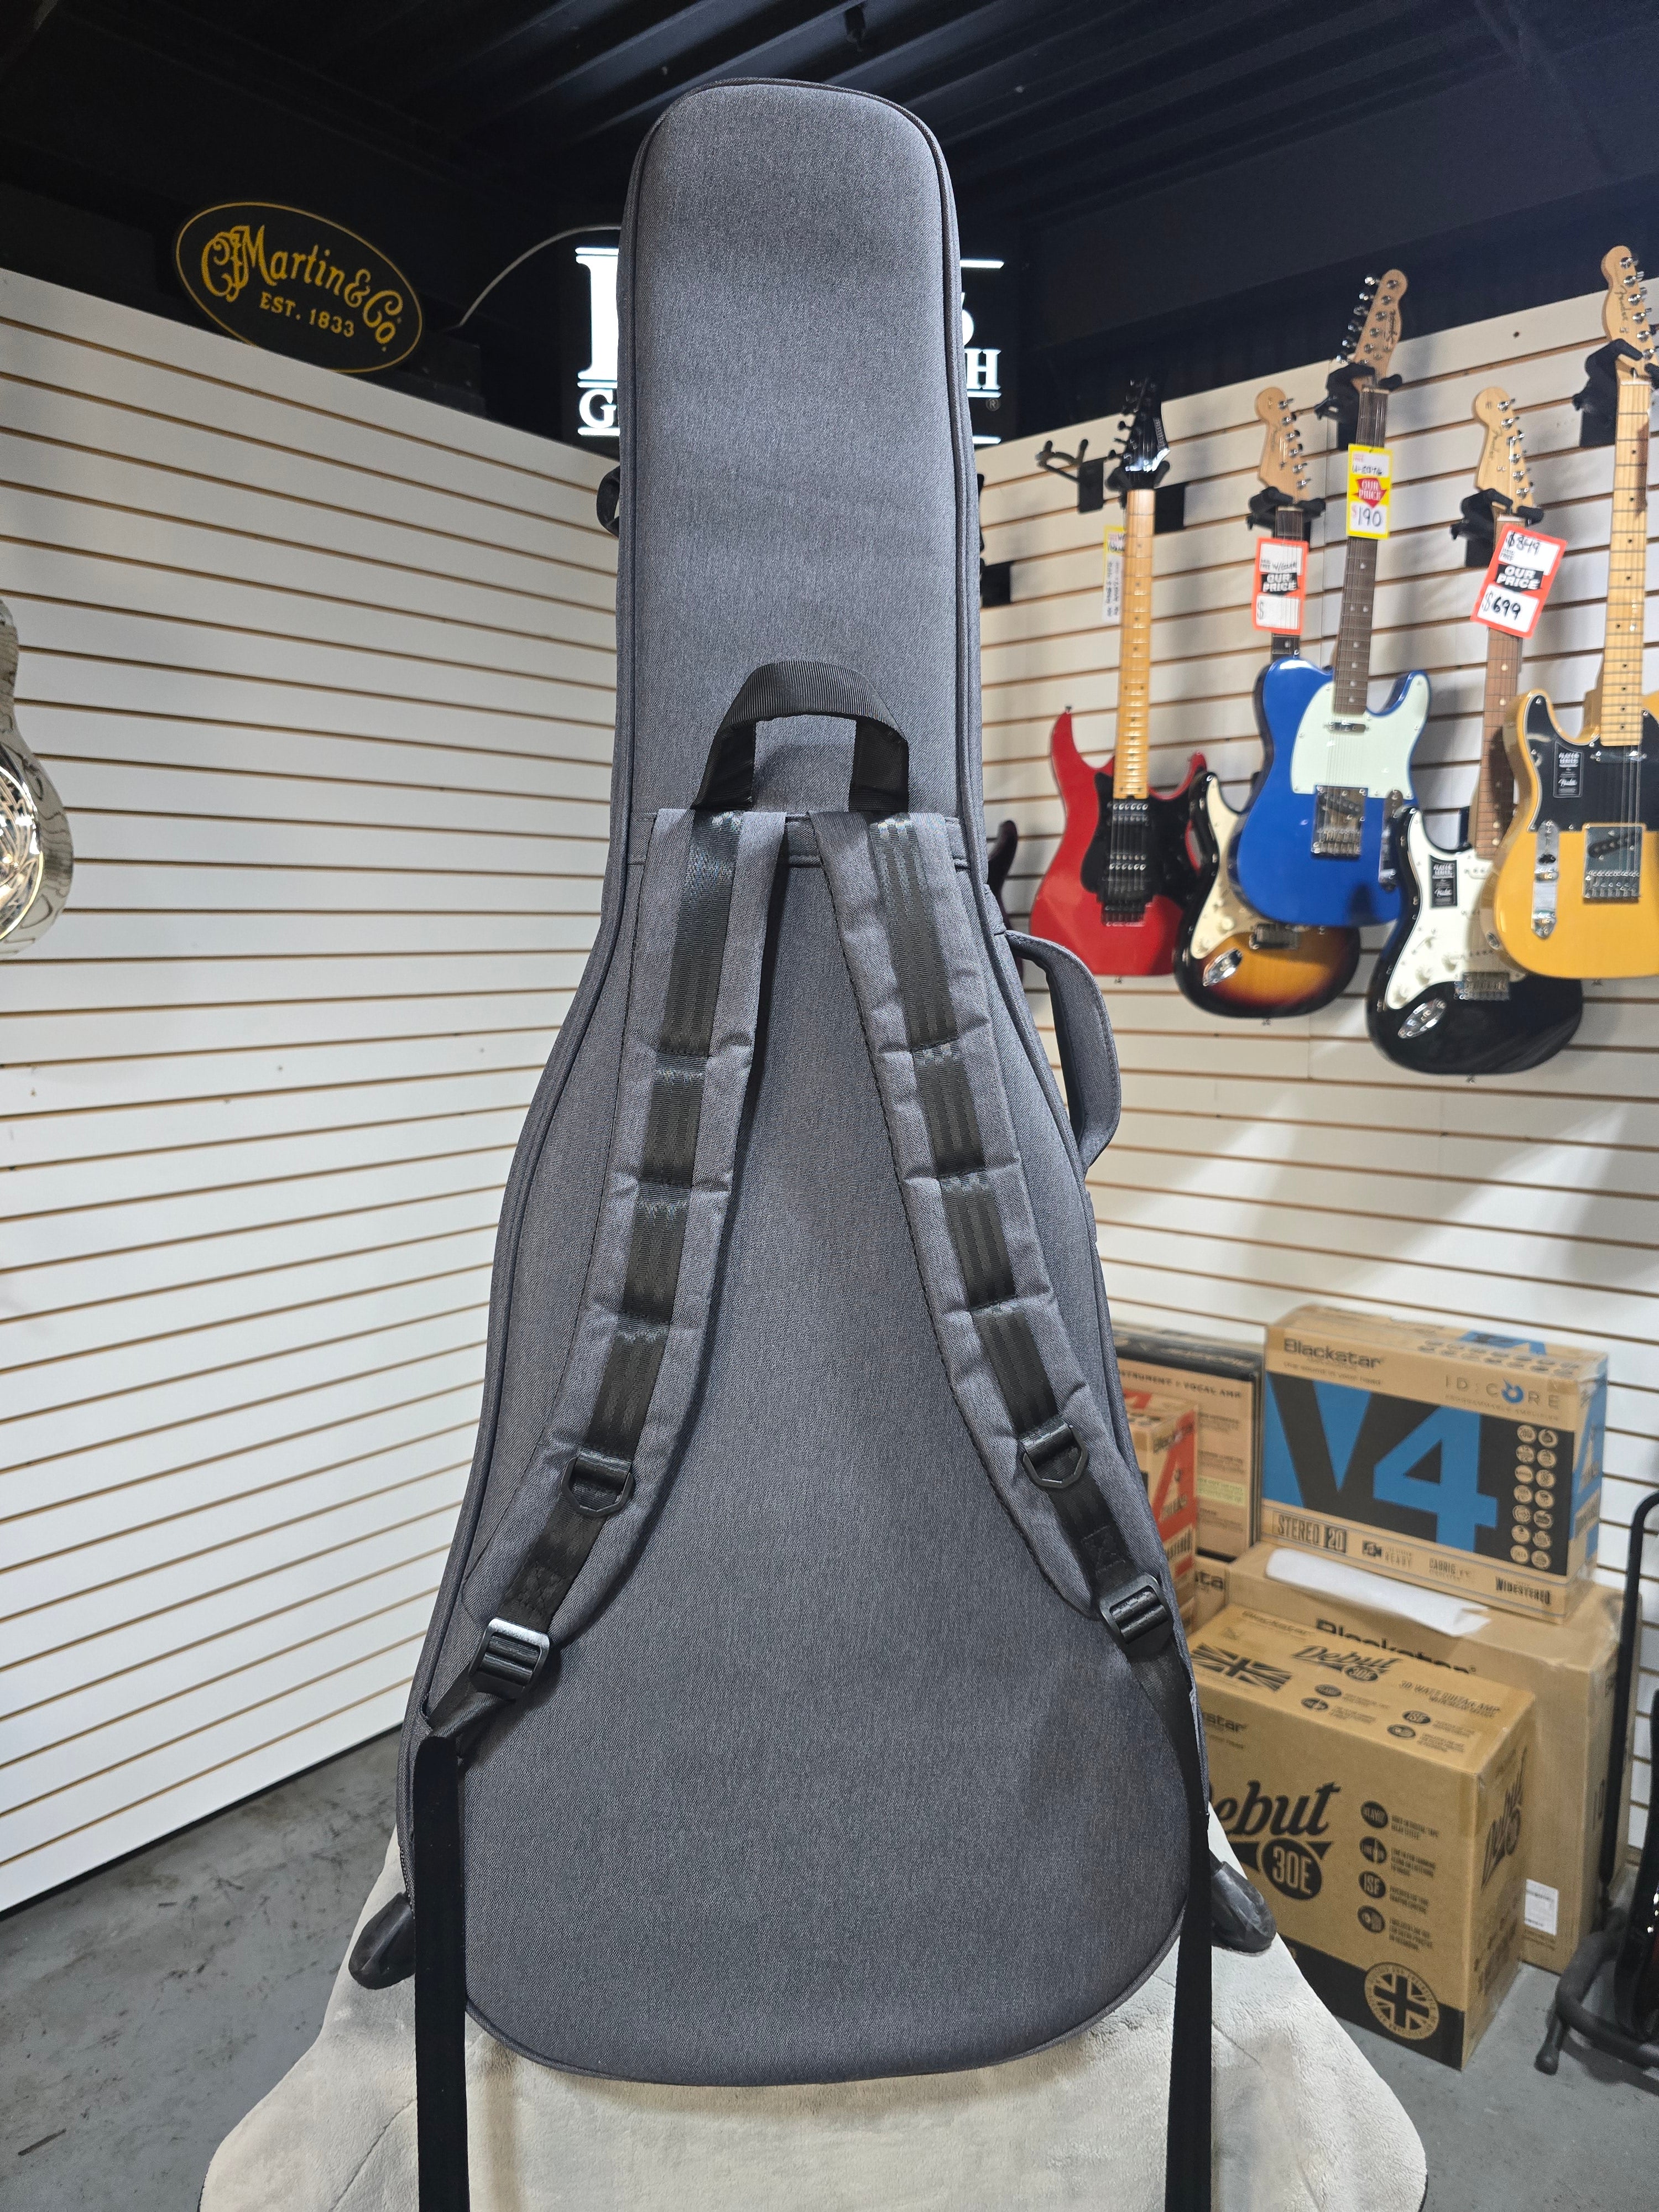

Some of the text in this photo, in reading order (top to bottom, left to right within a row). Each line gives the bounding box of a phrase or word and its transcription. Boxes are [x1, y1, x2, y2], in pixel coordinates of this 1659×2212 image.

[259, 291, 355, 338] EST. 1833
[1358, 488, 1382, 501] PRICE
[1361, 479, 1380, 492] OUR
[1266, 573, 1290, 583] OUR
[1496, 573, 1541, 590] PRICE
[1504, 565, 1536, 580] OUR
[1262, 582, 1297, 593] PRICE
[1481, 591, 1521, 621] $699
[1284, 1337, 1383, 1369] Blackstar
[1278, 1513, 1320, 1545] STEREO
[1327, 1526, 1347, 1553] 20
[1477, 1702, 1501, 1714] AMP
[1209, 1779, 1341, 1836] ebut
[1272, 1845, 1313, 1896] 30E
[1363, 1872, 1381, 1895] ISF
